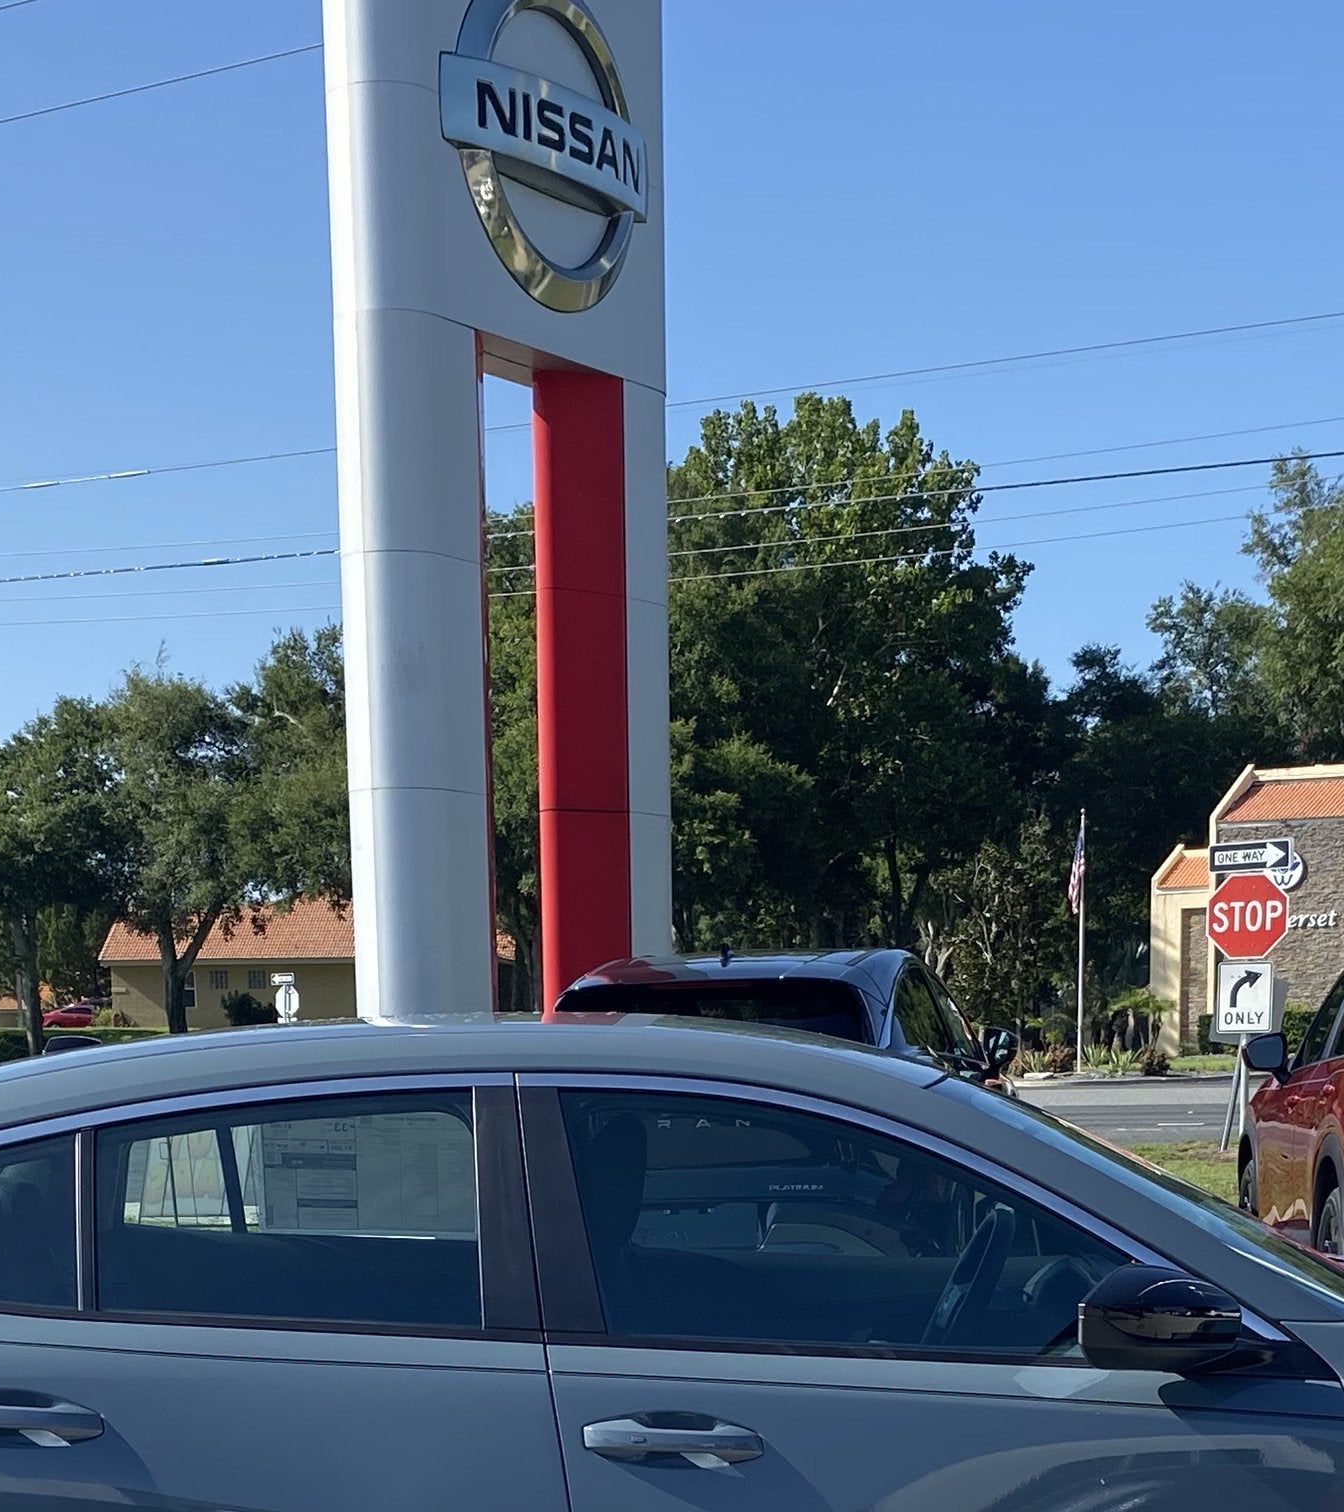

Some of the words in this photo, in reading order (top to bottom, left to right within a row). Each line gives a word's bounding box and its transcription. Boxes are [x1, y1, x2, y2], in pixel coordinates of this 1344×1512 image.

[476, 79, 641, 194] NISSAN
[1217, 852, 1239, 864] ONE
[1242, 850, 1266, 863] WAY
[1212, 900, 1283, 933] STOP
[1287, 910, 1338, 928] erset
[1224, 1011, 1265, 1025] ONLY
[657, 1119, 751, 1129] RAN
